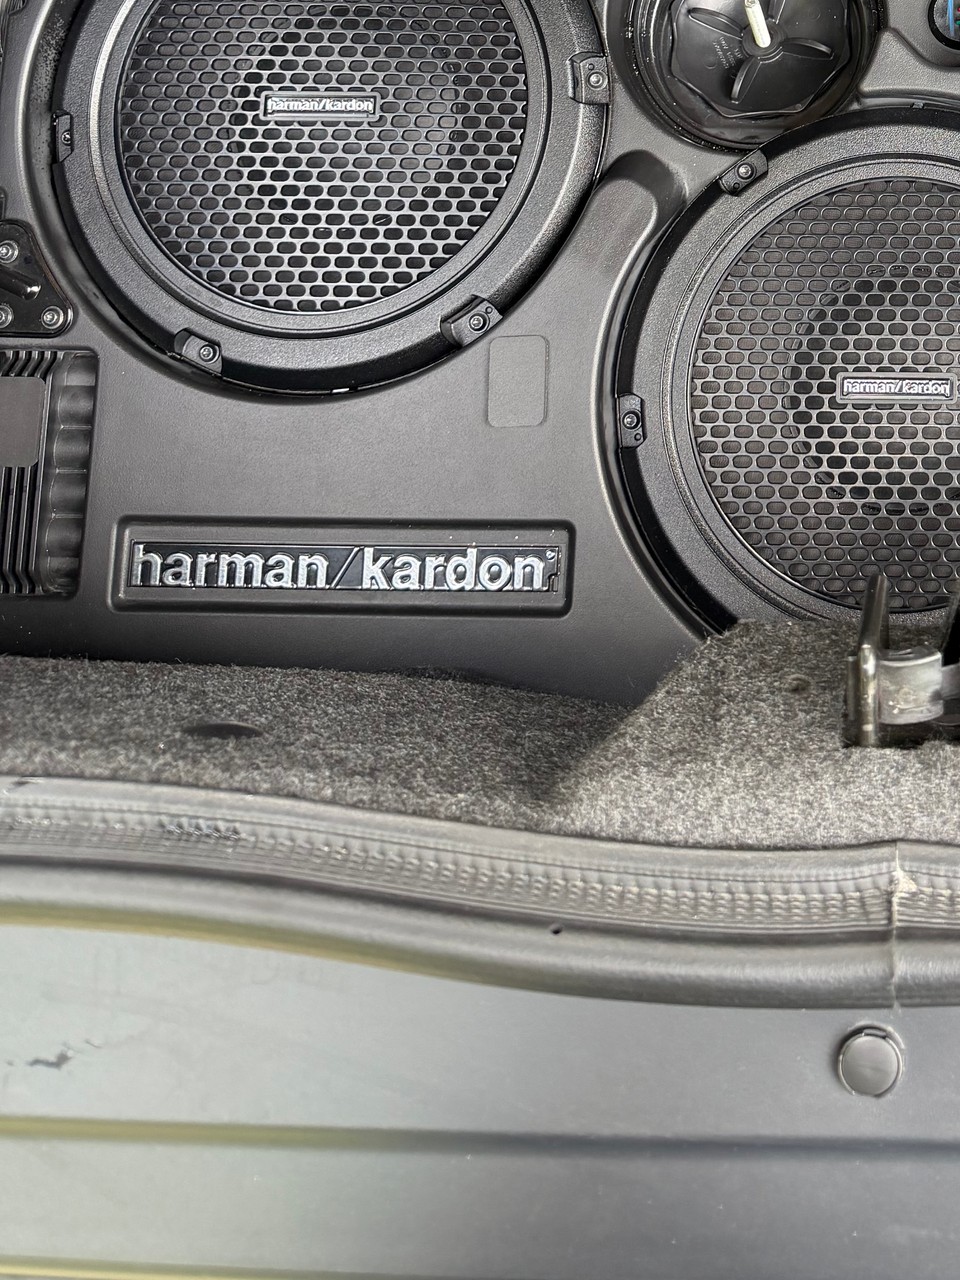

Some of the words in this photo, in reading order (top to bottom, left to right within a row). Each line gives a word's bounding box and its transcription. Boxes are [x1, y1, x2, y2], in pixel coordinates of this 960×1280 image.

[267, 97, 374, 111] harman/kardon
[843, 379, 950, 394] harman/kardon
[133, 544, 546, 591] harman/kardon
